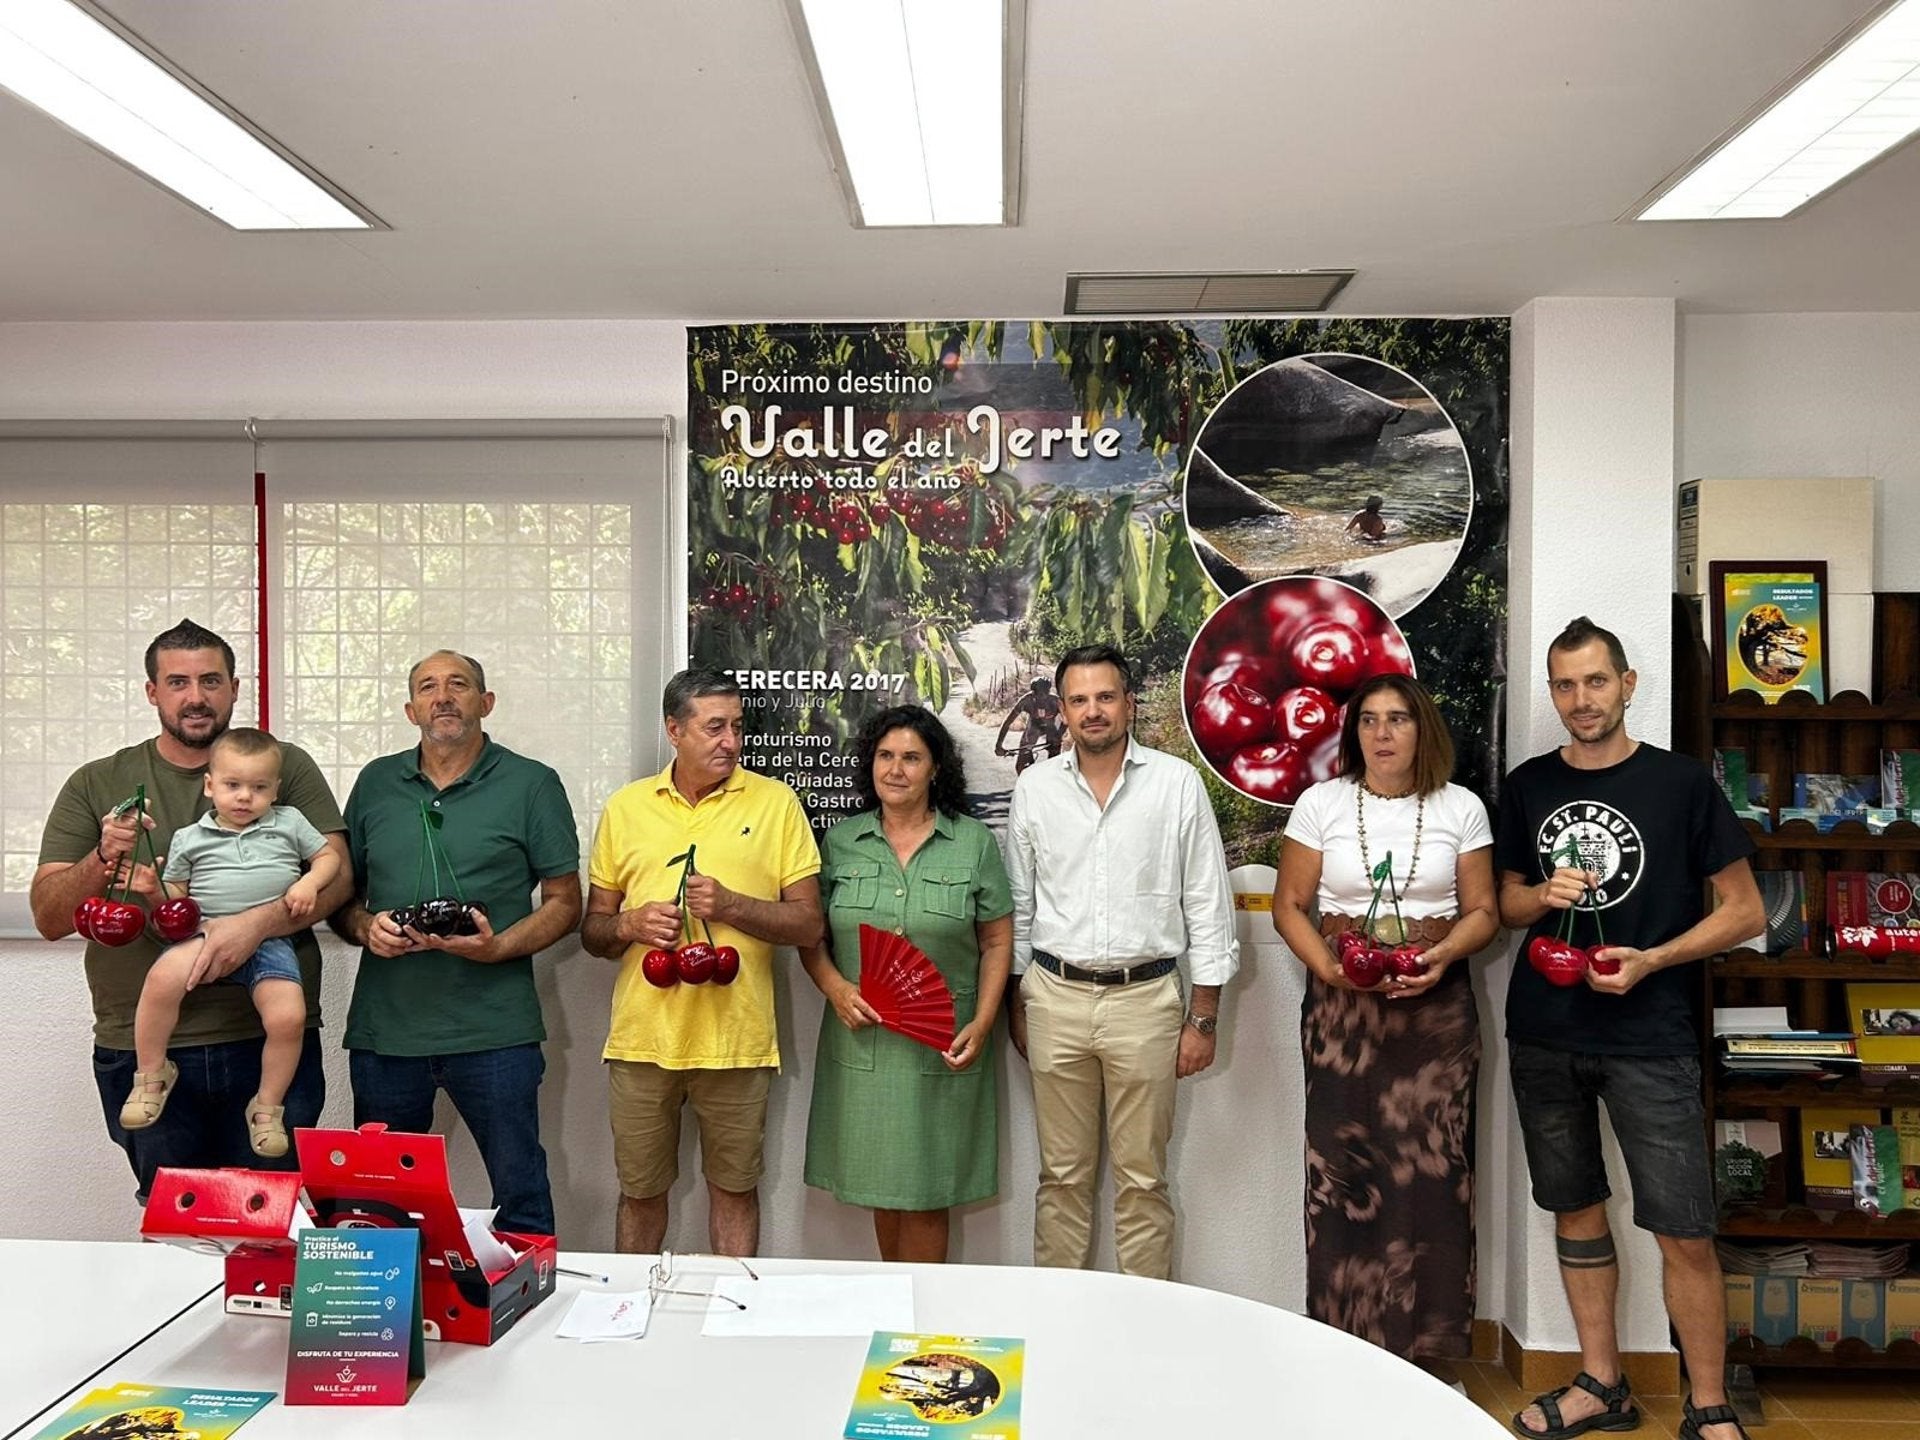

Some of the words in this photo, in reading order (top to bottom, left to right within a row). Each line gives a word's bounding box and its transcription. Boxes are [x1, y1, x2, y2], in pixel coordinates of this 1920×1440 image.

[721, 368, 830, 393] Próximo
[838, 369, 932, 393] destino
[720, 404, 890, 458] Valle
[904, 427, 955, 458] del
[966, 404, 1121, 474] Jerte
[720, 465, 814, 489] Abierto
[824, 466, 877, 489] todo
[887, 466, 909, 489] el
[917, 471, 961, 489] año
[850, 671, 906, 693] 2017
[742, 692, 767, 709] nio
[771, 696, 781, 712] y
[784, 693, 826, 709] Julio
[743, 731, 832, 747] roturismo
[771, 751, 793, 767] de
[798, 751, 814, 767] la
[819, 751, 860, 767] Cere
[807, 792, 865, 808] Gastro
[1539, 832, 1555, 854] FC
[1552, 809, 1579, 831] ST.
[1585, 805, 1639, 853] PAULI
[303, 1242, 356, 1251] TURISMO
[303, 1251, 374, 1260] SOSTENIBLE
